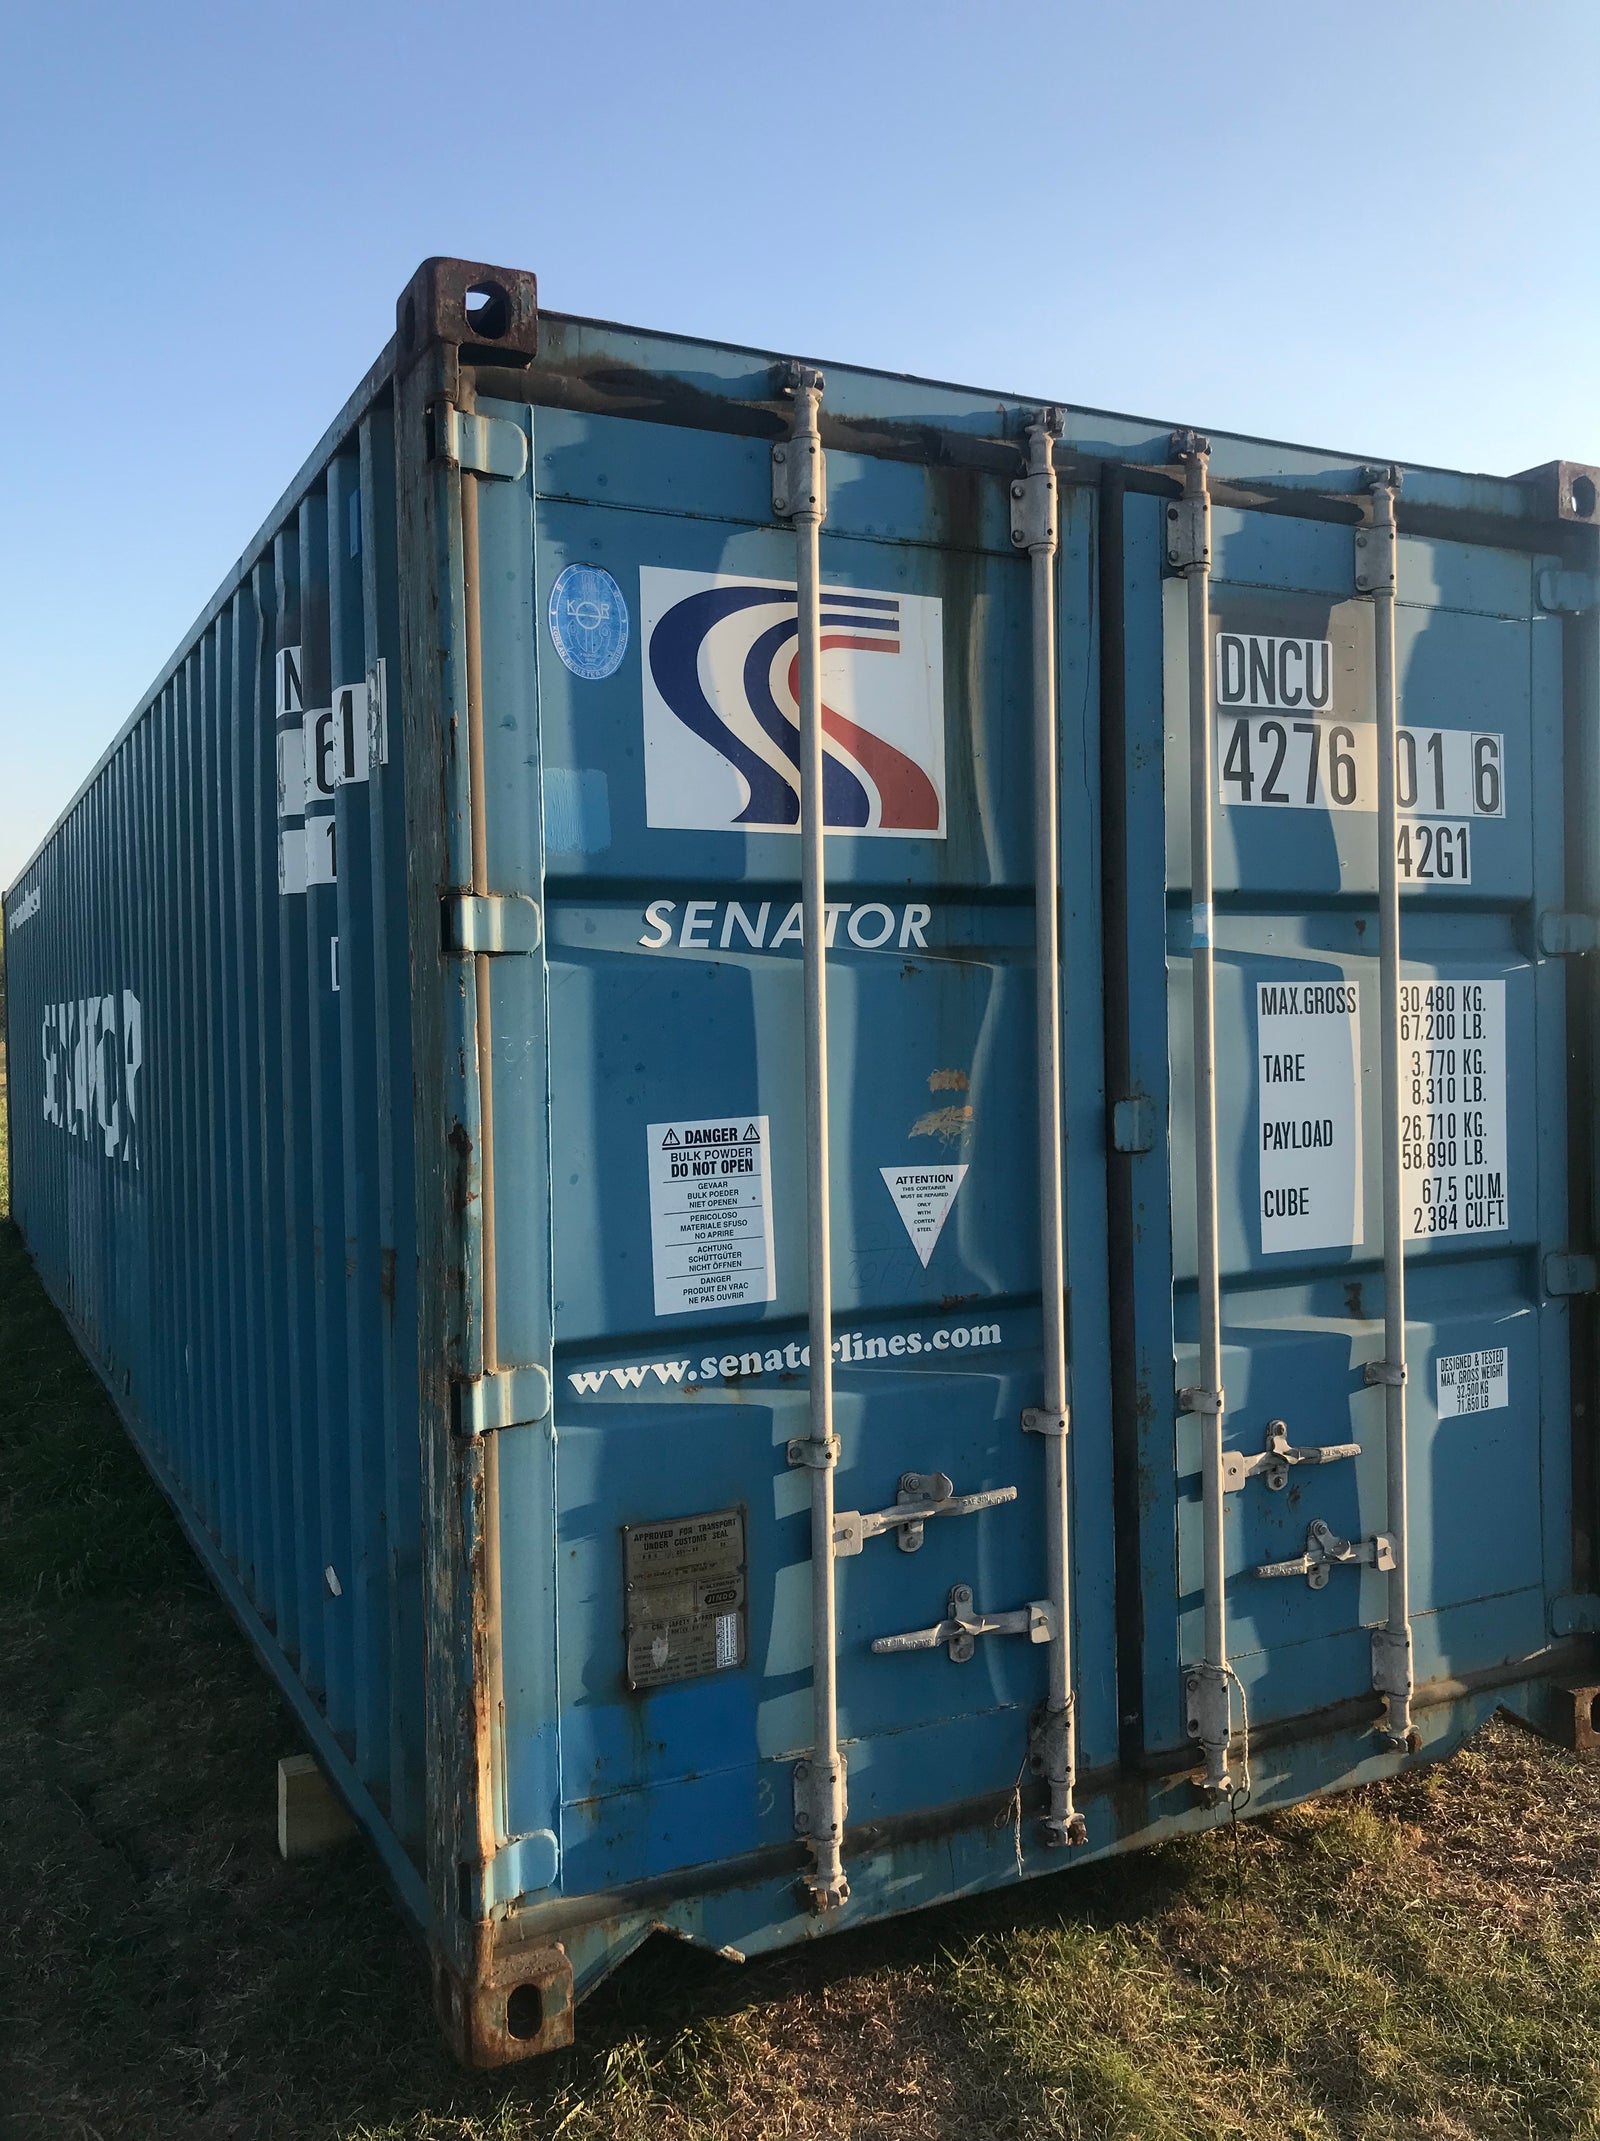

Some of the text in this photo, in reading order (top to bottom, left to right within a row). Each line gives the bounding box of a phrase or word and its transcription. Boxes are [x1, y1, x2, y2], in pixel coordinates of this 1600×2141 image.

[1221, 635, 1329, 708] DNCU
[1474, 737, 1499, 812] 6
[1398, 825, 1467, 878] 42G1
[638, 900, 932, 948] SENATOR
[1261, 985, 1486, 1015] MAX.GROSS 30,480 KG.
[1401, 1014, 1486, 1041] 67,200 LB.
[1263, 1049, 1486, 1083] TARE 3,770 KG.
[1412, 1076, 1486, 1106] 8,310 LB.
[685, 1128, 737, 1144] DANGER
[1263, 1112, 1487, 1150] PAYLOAD 26,710 KG.
[671, 1148, 752, 1163] BULK POWDER
[1402, 1139, 1487, 1170] 58,890 LB.
[671, 1158, 753, 1177] DO NOT OPEN
[698, 1181, 728, 1189] GEVAAR
[896, 1174, 953, 1185] ATTENTION
[709, 1189, 738, 1198] POEDER
[1263, 1172, 1504, 1217] CUBE 67.5 CU.M.
[690, 1199, 737, 1208] NIET OPENEN
[690, 1212, 737, 1221] PERICOLOSO
[1414, 1200, 1505, 1234] 2,384 CU.FT.
[680, 1220, 747, 1232] MATERIALE SFUSO
[707, 1230, 734, 1238] APRIRE
[697, 1244, 732, 1252] ACHTUNG
[688, 1251, 742, 1263] SCHÜTTGÜTER
[689, 1260, 741, 1272] NICHT ÖFFNEN
[701, 1275, 731, 1285] DANGER
[683, 1282, 748, 1296] PRODUIT EN VRAC
[700, 1295, 715, 1303] PAS
[717, 1292, 744, 1301] OUVRIR
[1441, 1350, 1503, 1372] DESIGNED & TESTED
[1441, 1364, 1503, 1387] MAX. GROSS WEIGHT
[1480, 1381, 1488, 1394] KG
[1481, 1395, 1489, 1409] LB
[634, 1518, 736, 1542] APPROVED FOR TRANSPORT
[644, 1529, 728, 1550] UNDER CUSTOMS SEAL
